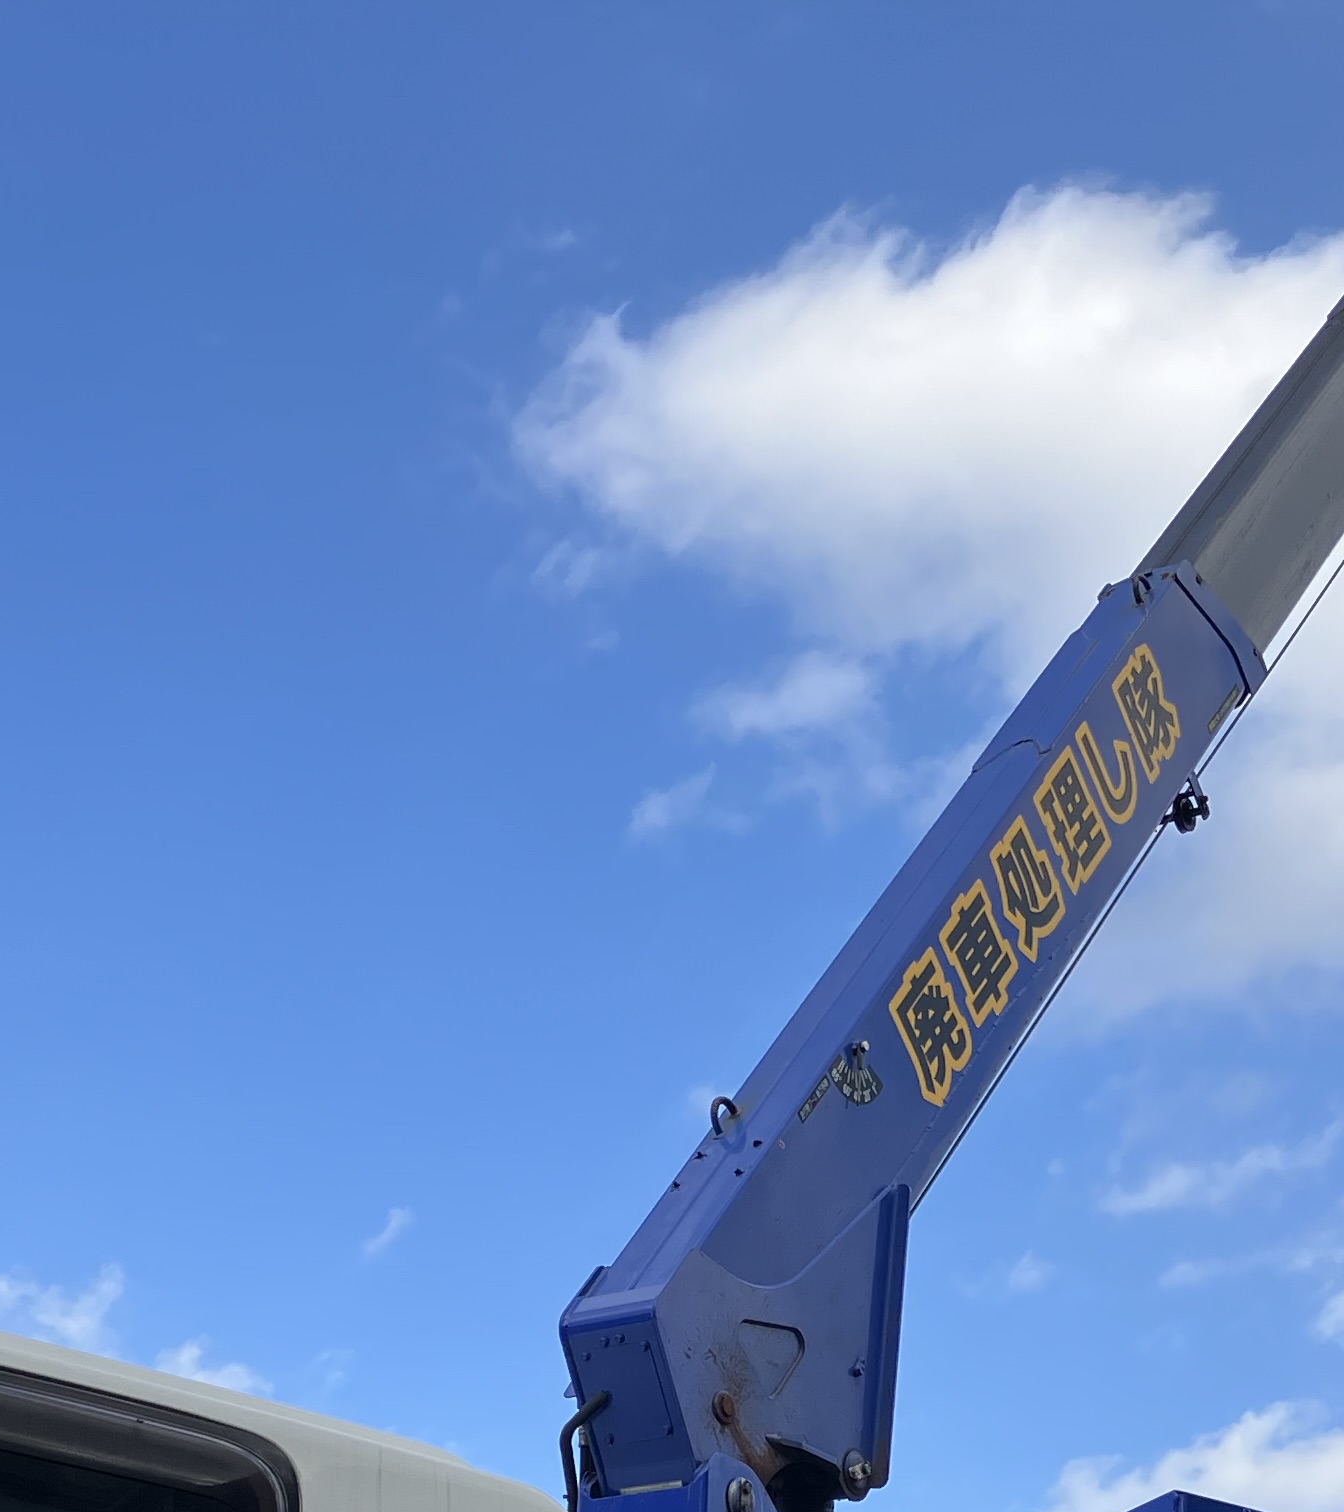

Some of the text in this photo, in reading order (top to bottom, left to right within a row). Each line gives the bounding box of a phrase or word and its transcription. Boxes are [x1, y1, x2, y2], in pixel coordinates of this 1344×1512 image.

[889, 643, 1181, 1107] 廃車処理し隊
